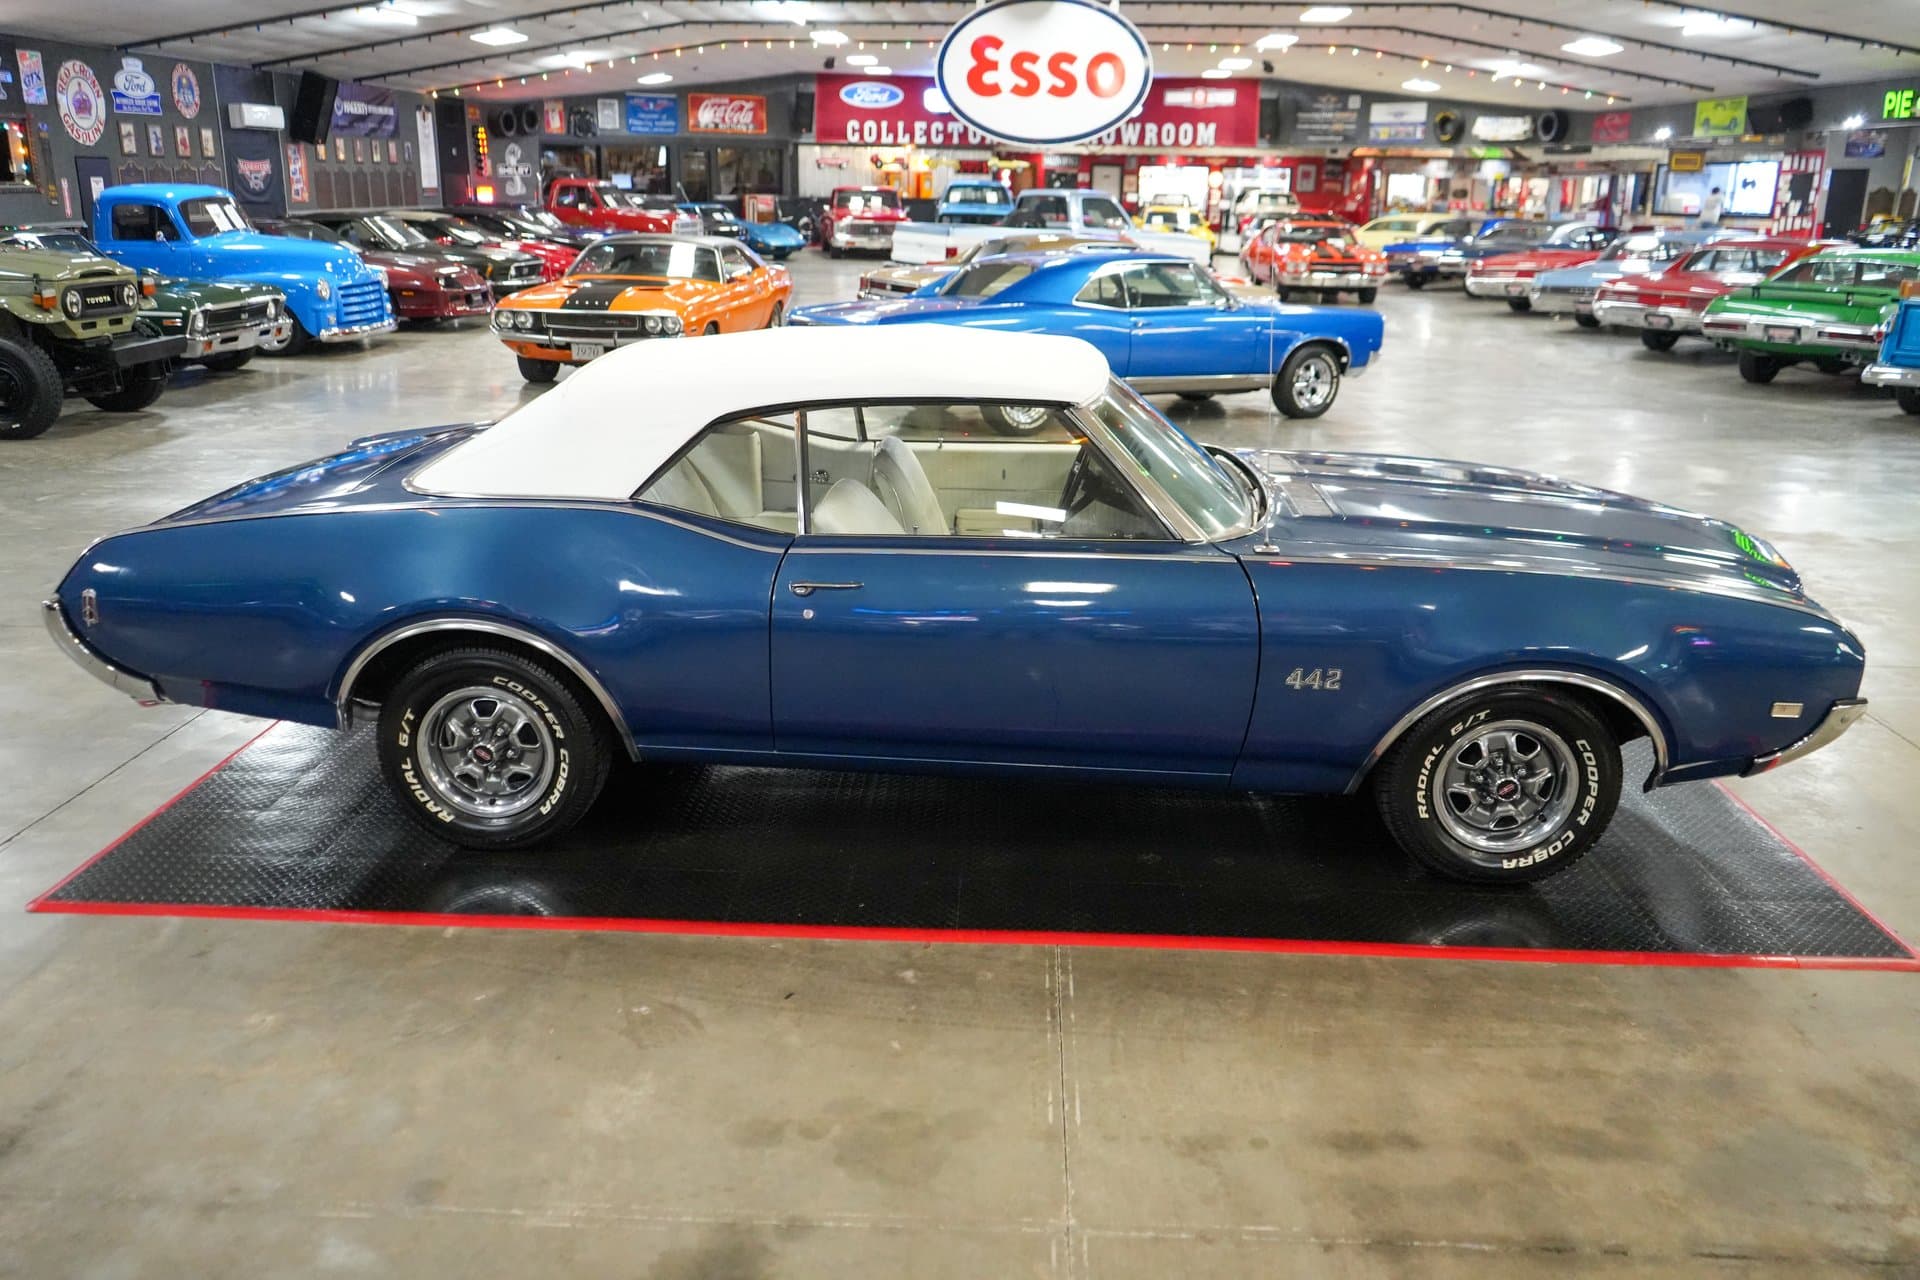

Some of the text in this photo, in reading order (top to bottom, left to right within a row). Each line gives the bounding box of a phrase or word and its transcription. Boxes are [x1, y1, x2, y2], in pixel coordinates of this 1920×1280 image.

[58, 67, 71, 95] RED
[124, 74, 147, 92] Ford
[852, 87, 891, 103] Ford
[1883, 90, 1914, 119] PIE
[63, 113, 105, 143] GASOLINE
[846, 119, 998, 145] COLLECTO
[86, 295, 112, 305] TOYOTA
[1285, 668, 1343, 690] 442
[493, 675, 570, 816] COOPER COBRA
[398, 708, 456, 823] RADIAL G/T
[1416, 709, 1492, 820] RADIAL G/T
[1502, 739, 1600, 870] COOPER COBRA
